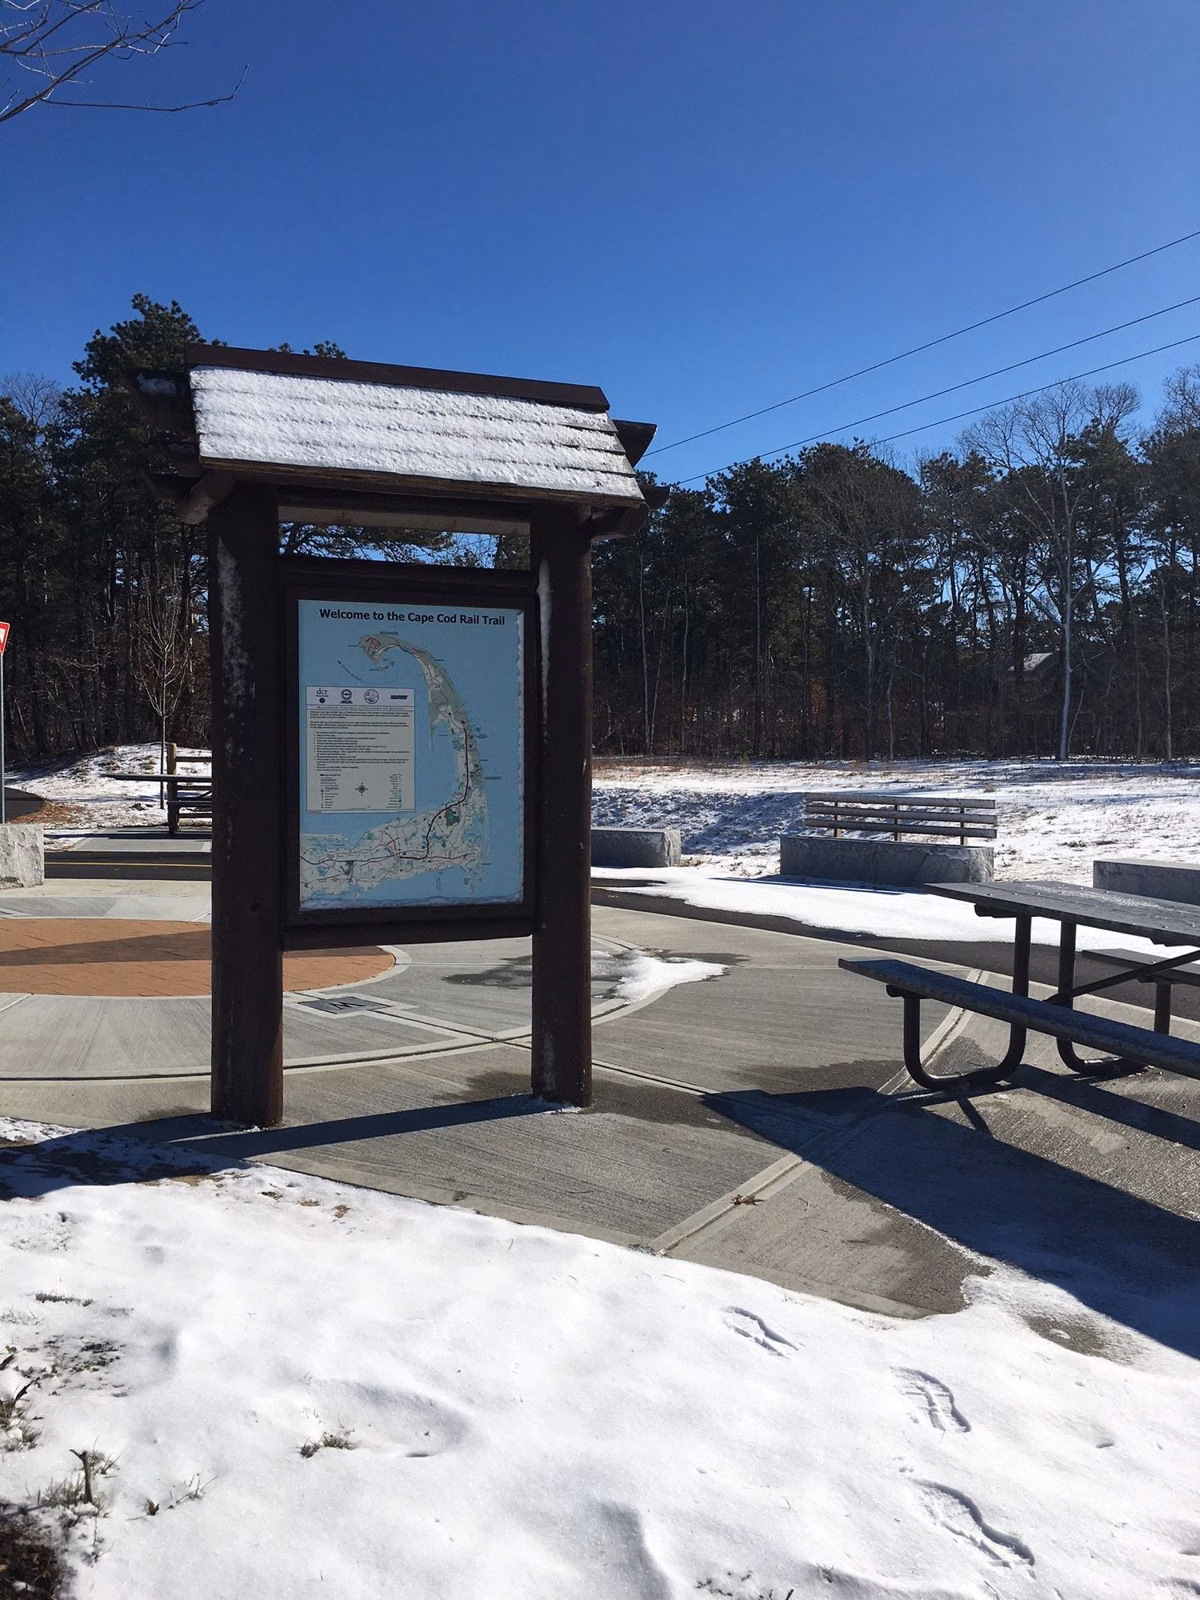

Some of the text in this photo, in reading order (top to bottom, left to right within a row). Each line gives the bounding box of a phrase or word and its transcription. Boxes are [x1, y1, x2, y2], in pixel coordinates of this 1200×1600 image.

[319, 608, 506, 626] Welcome to the Cape Cod Rail Trail
